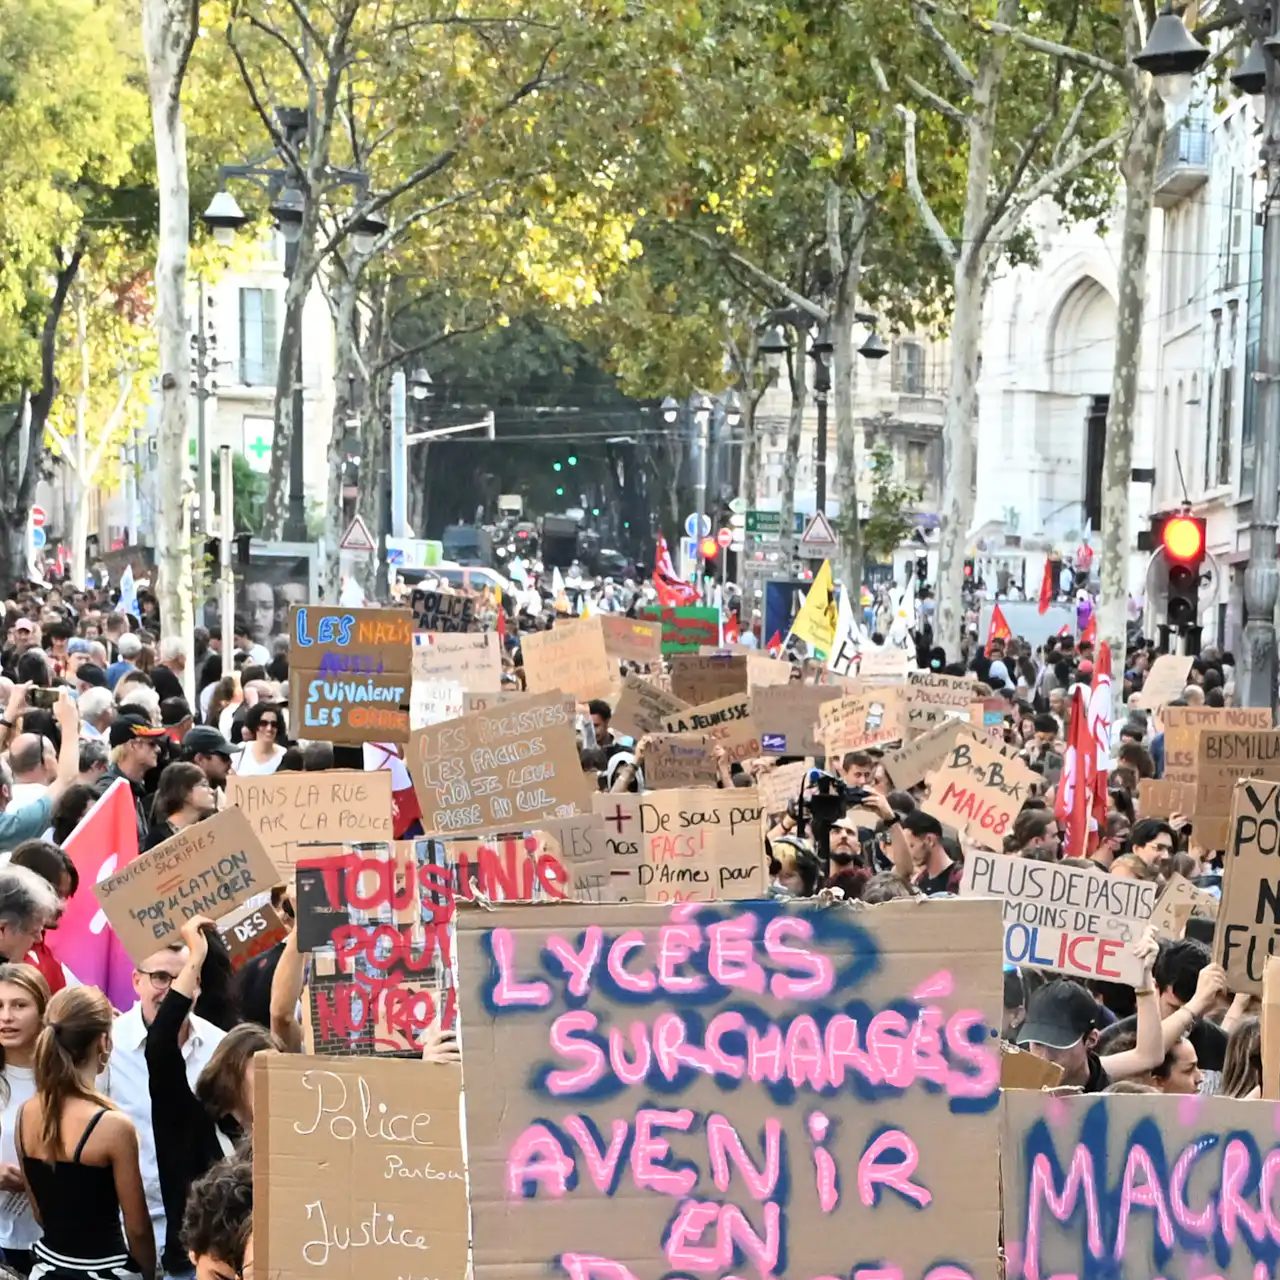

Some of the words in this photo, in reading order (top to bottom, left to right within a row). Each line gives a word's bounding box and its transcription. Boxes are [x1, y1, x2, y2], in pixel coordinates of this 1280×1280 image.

[412, 590, 476, 618] POLICE
[297, 608, 355, 647] LES
[305, 704, 342, 726] LES
[667, 719, 688, 733] LA
[690, 702, 750, 731] JEUNESSE
[1225, 711, 1269, 729] NOUS
[419, 728, 472, 764] LES
[1166, 751, 1194, 767] LES
[423, 757, 466, 789] LES
[235, 784, 289, 812] DANS
[294, 785, 320, 808] LA
[331, 784, 369, 802] RUE
[436, 778, 471, 808] MOI
[472, 775, 503, 796] JE
[258, 814, 287, 834] AR
[299, 811, 331, 831] LA
[339, 812, 391, 831] POLICE
[433, 804, 483, 833] PISSE
[490, 796, 513, 819] AU
[517, 788, 557, 811] CUL
[640, 804, 671, 834] De
[155, 831, 217, 876] SACRIFIES
[560, 826, 593, 858] LES
[606, 840, 639, 855] nos
[101, 859, 152, 898] SERVICES
[296, 852, 456, 923] TOUS
[638, 864, 710, 886] D'Armes
[720, 865, 760, 888] pour
[971, 856, 1047, 900] PLUS
[1050, 871, 1085, 907] DE
[1086, 876, 1152, 920] PASTIS
[151, 921, 177, 940] EN
[182, 868, 257, 919] DANGER
[1003, 900, 1069, 930] MOINS
[1073, 911, 1100, 934] DE
[233, 912, 268, 943] DES
[487, 902, 836, 1008] LYCÉES
[1004, 922, 1125, 978] OLICE
[544, 970, 1001, 1097] SURCHARGÉS
[294, 1069, 435, 1146] Police
[384, 1155, 465, 1180] Partou
[303, 1200, 431, 1267] Justice
[664, 1199, 783, 1278] EN
